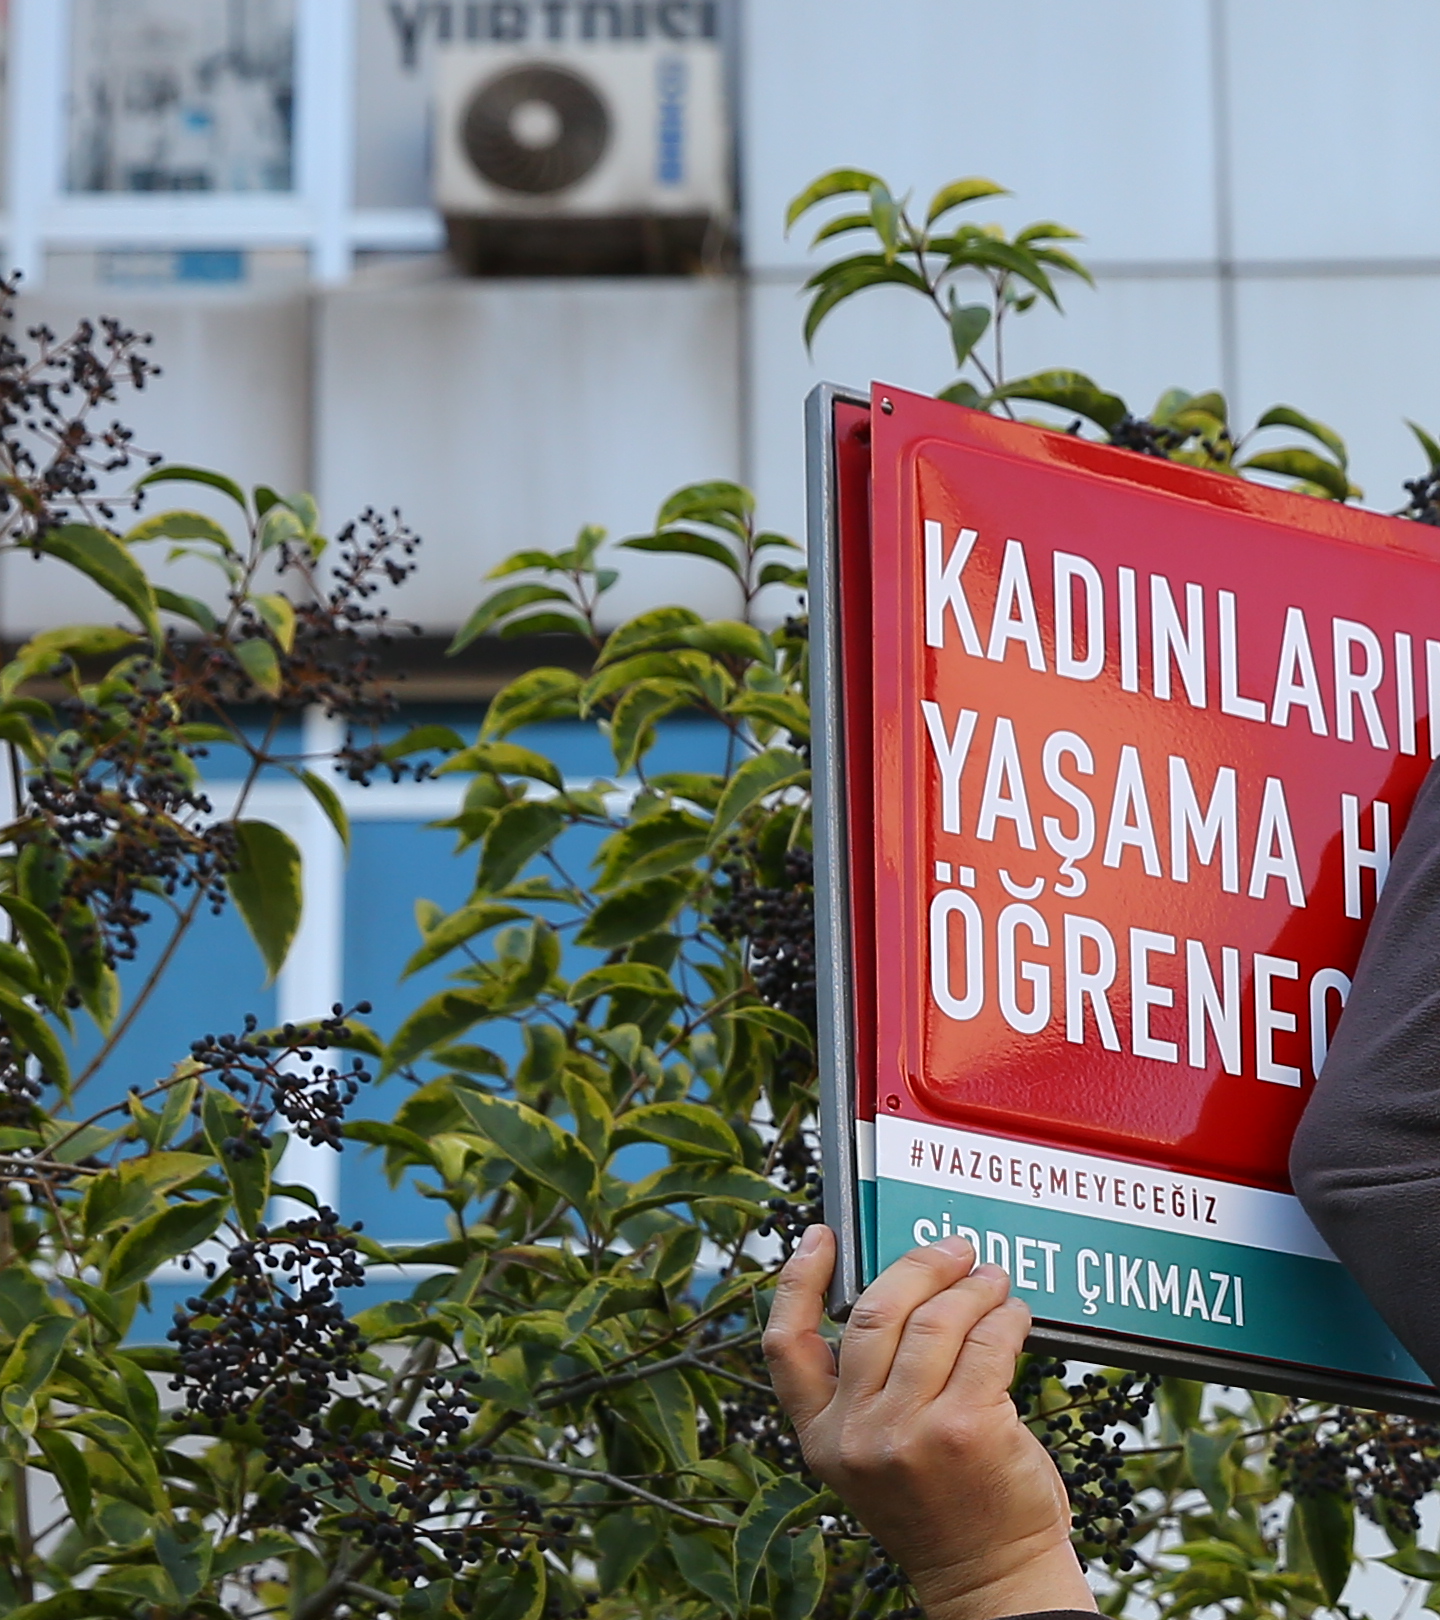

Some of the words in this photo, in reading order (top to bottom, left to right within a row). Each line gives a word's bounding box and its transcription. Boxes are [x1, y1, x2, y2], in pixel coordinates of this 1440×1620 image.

[921, 700, 1307, 908] YAŞAMA
[910, 1138, 1220, 1226] #VAZGEÇMEYECEĞİZ
[1075, 1248, 1246, 1328] ÇIKMAZI
